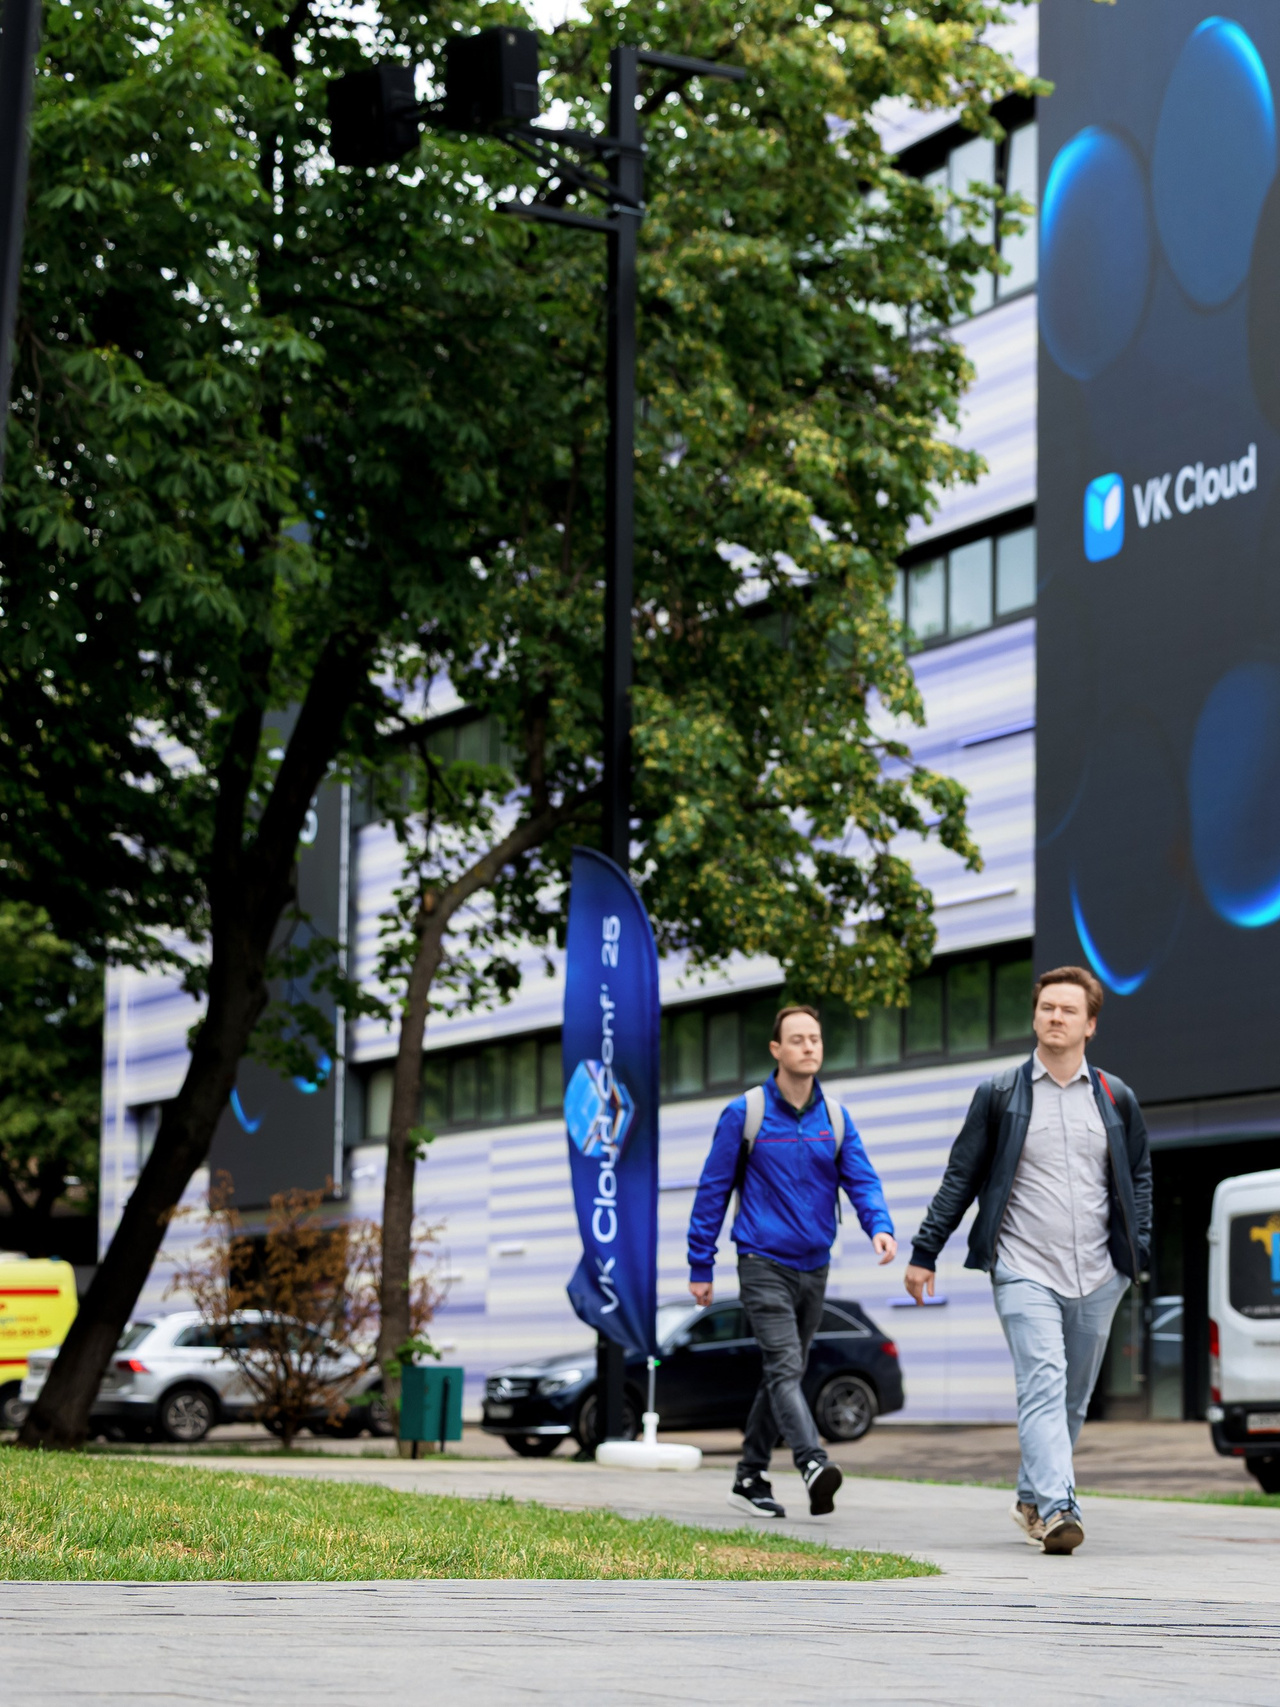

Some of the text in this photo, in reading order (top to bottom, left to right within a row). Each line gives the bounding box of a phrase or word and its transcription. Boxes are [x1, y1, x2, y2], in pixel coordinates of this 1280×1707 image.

[1132, 442, 1257, 528] VK Cloud
[592, 1115, 619, 1243] Cloud
[595, 1256, 619, 1314] VK
